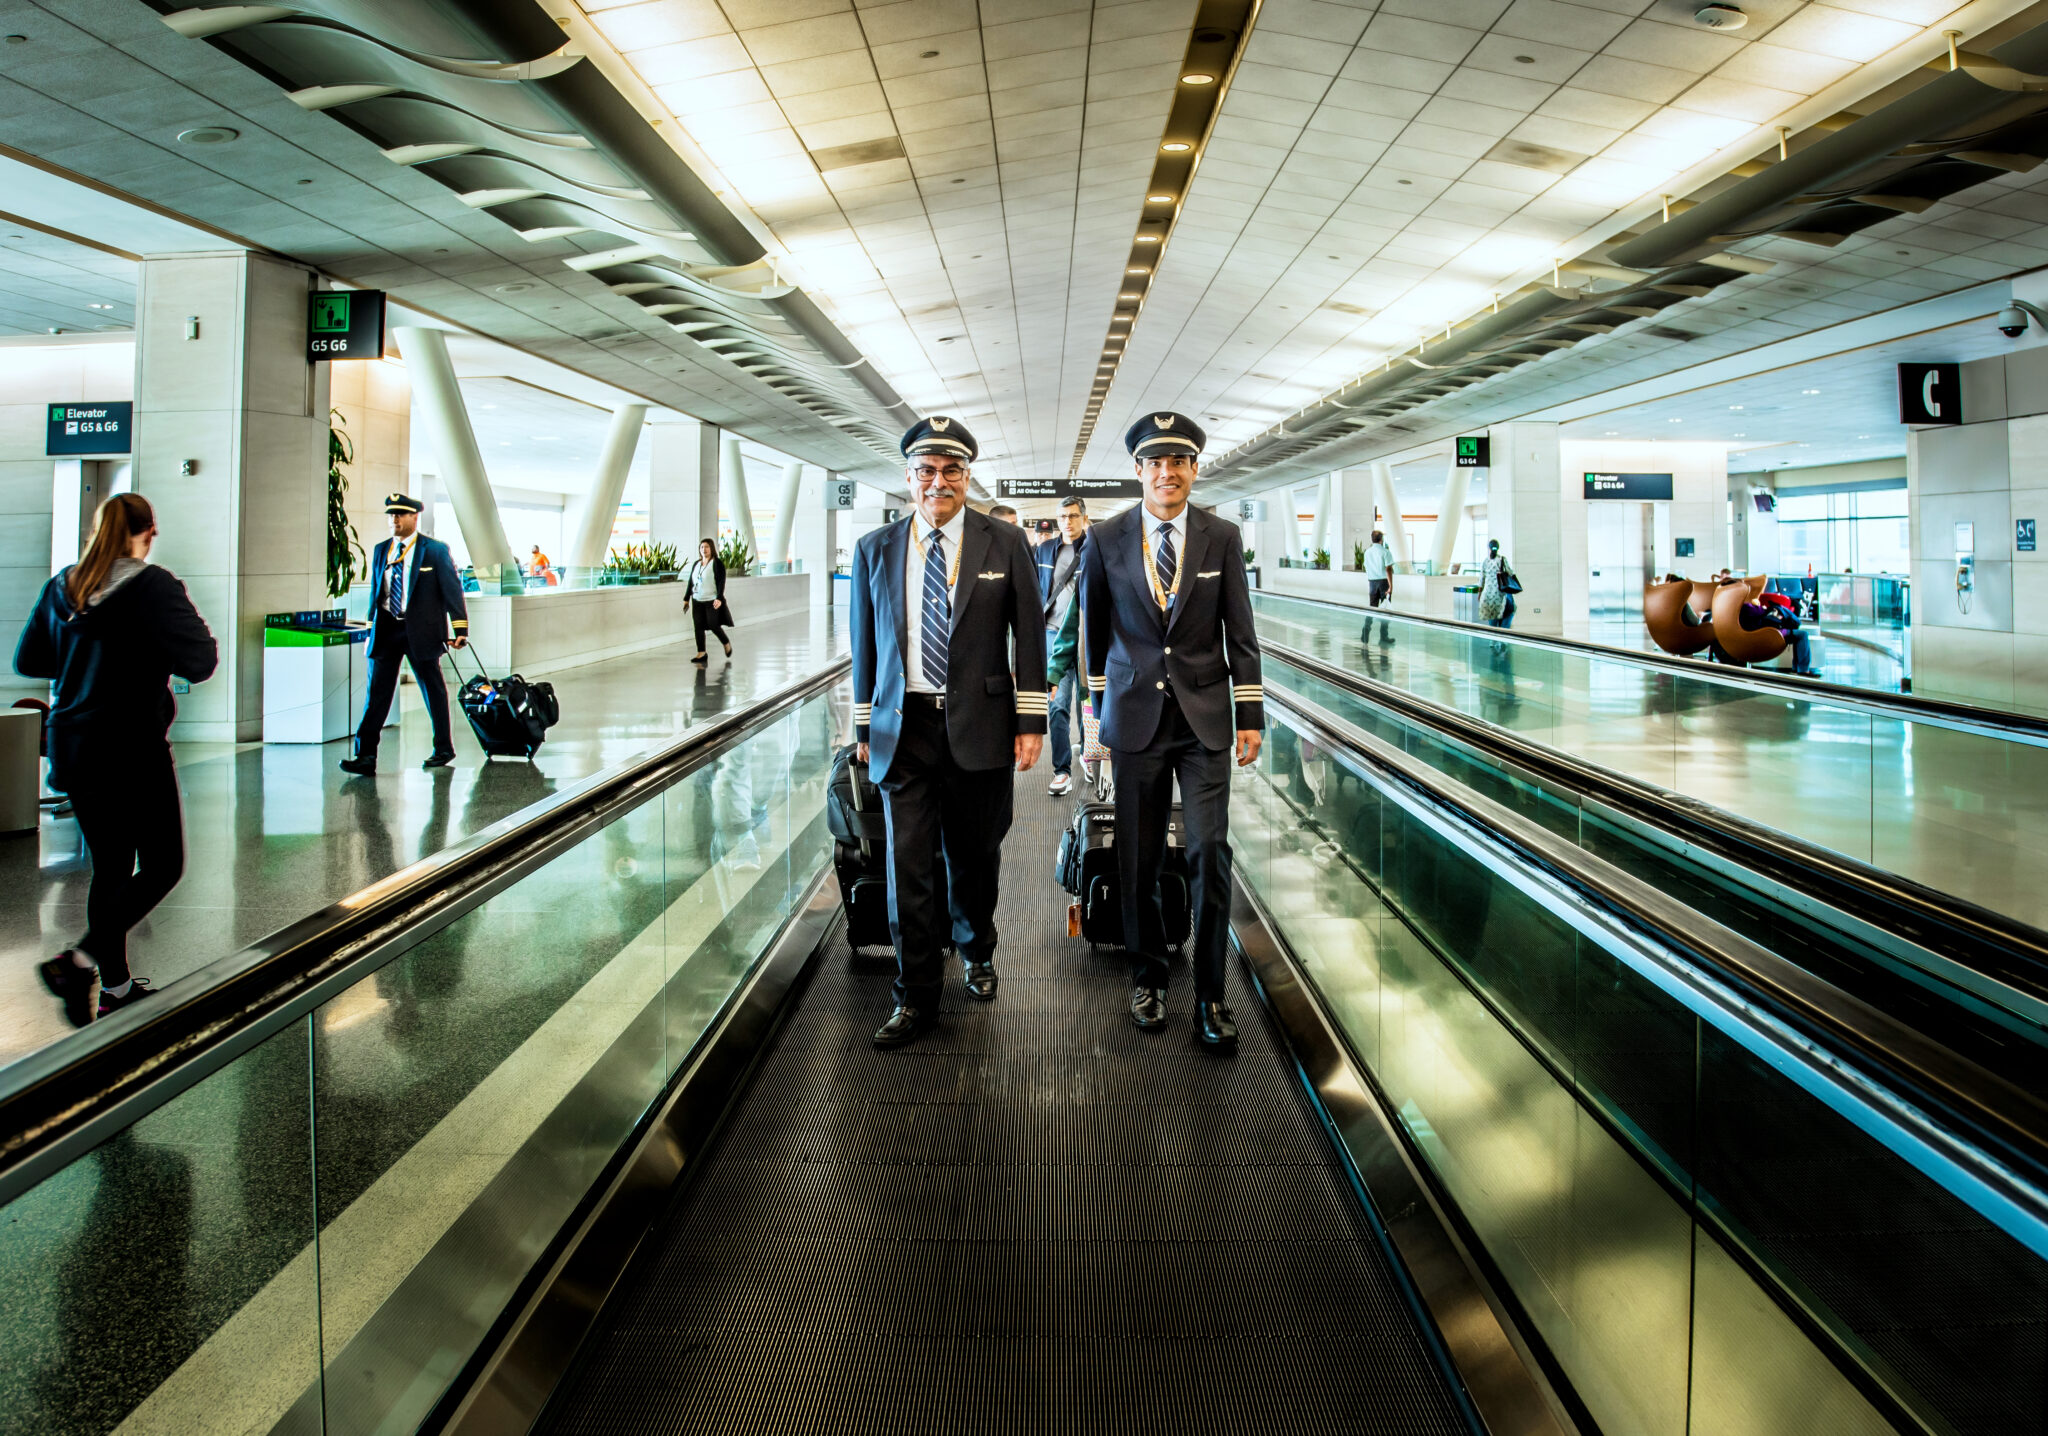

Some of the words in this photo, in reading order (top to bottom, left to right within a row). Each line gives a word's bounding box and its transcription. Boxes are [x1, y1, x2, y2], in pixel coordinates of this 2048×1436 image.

[311, 339, 328, 352] G5
[330, 339, 347, 352] G6
[67, 408, 108, 419] Elevator
[80, 422, 94, 433] G5
[95, 422, 103, 432] &
[104, 421, 119, 432] G6
[838, 484, 851, 495] G5
[1083, 480, 1105, 488] Baggage
[838, 495, 851, 506] G6
[1244, 503, 1254, 511] G3
[1244, 511, 1254, 520] G4
